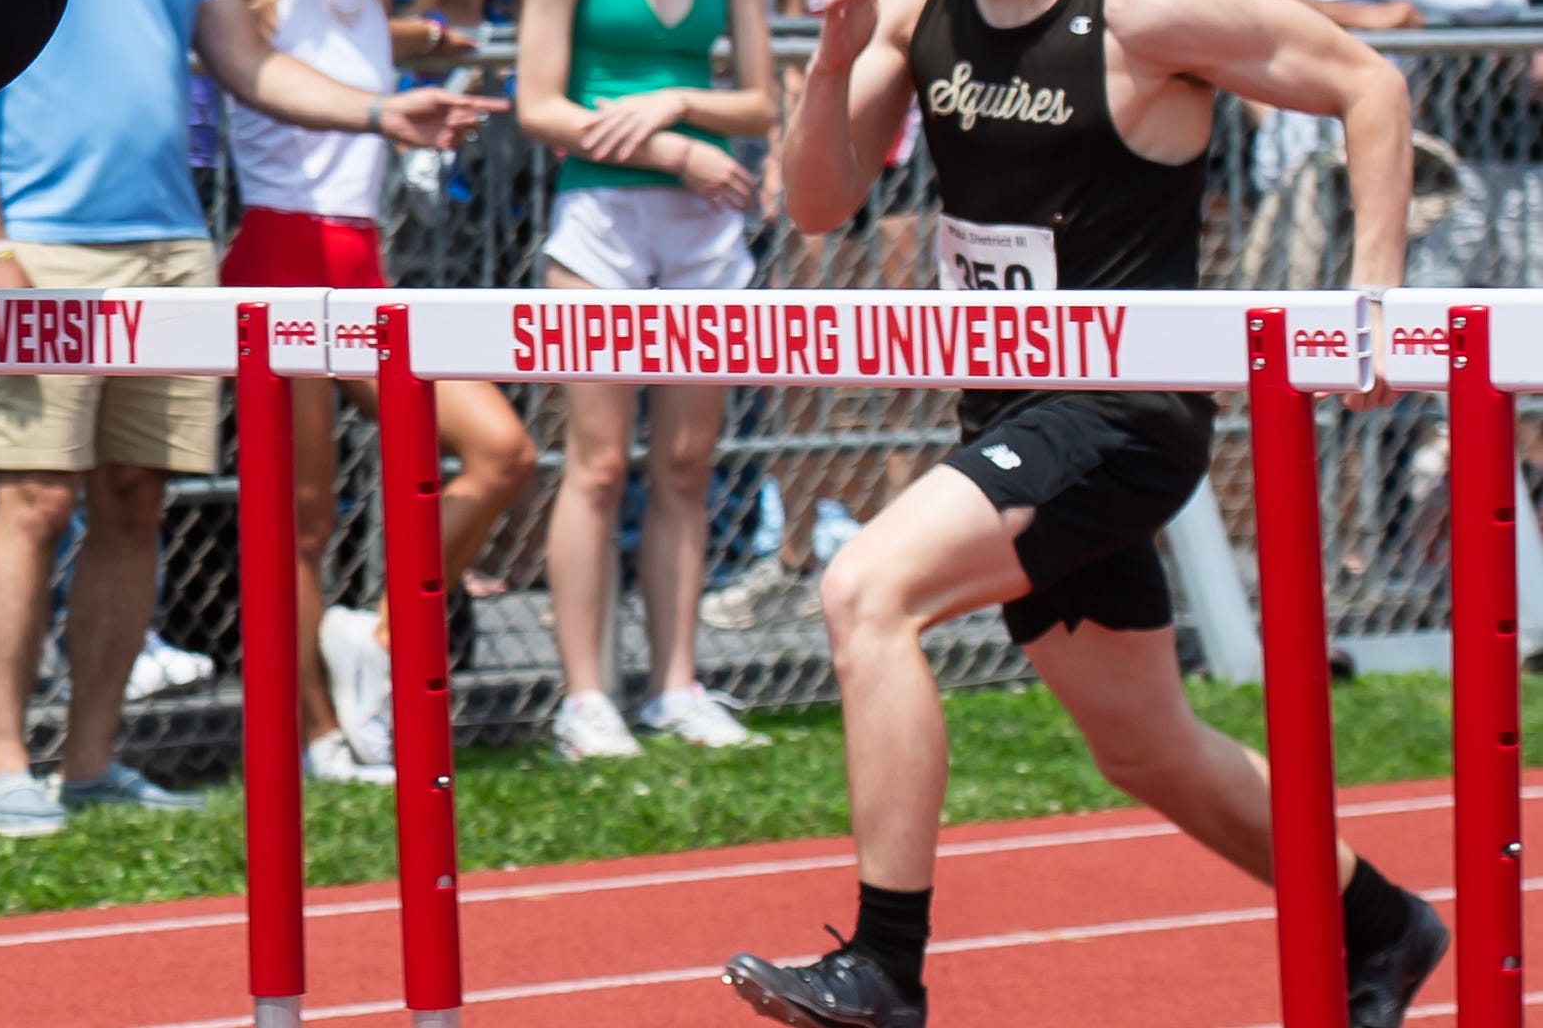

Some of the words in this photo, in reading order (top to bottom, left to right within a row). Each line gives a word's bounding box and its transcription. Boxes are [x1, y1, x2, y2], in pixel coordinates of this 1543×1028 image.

[929, 61, 1074, 131] Squires
[512, 303, 839, 375] SHIPPENSBURG
[857, 305, 1128, 378] UNIVERSITY
